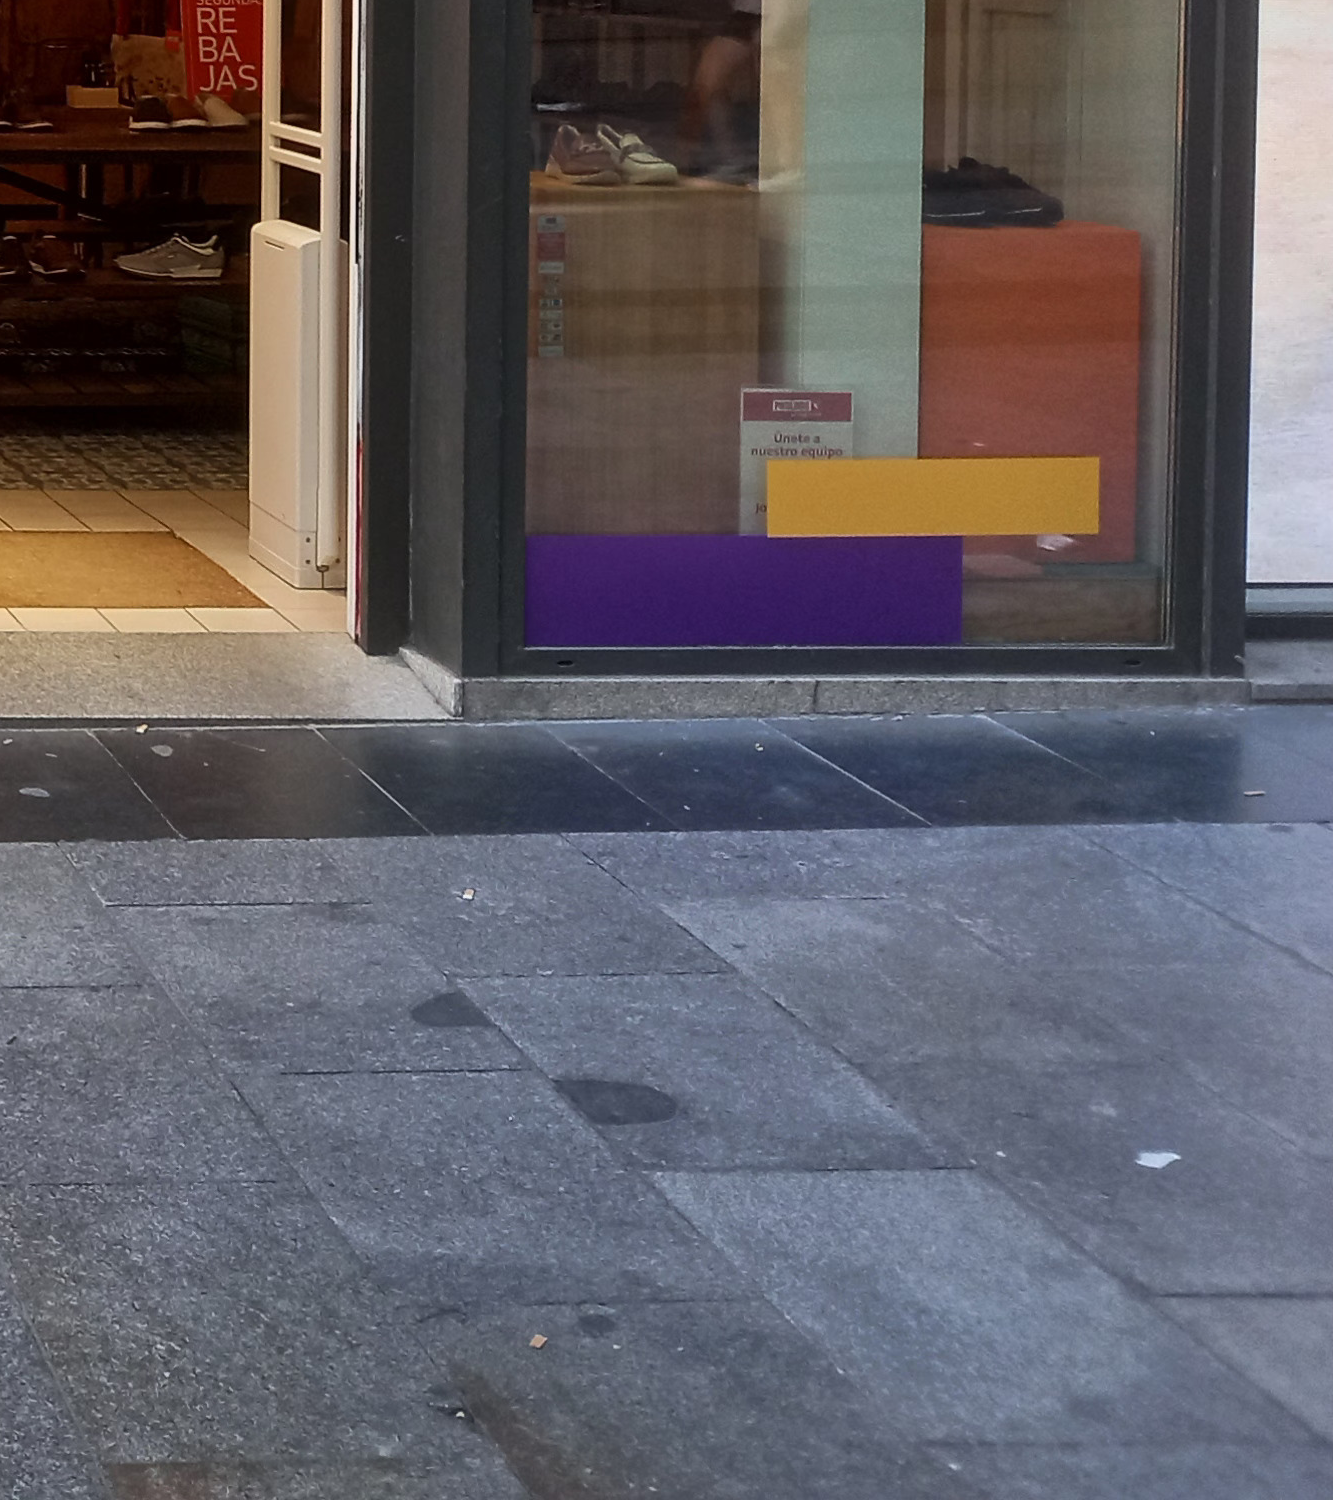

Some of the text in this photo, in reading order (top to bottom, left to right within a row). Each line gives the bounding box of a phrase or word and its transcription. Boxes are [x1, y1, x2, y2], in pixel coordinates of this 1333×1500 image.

[196, 7, 237, 33] RE
[198, 35, 241, 62] BA
[199, 64, 258, 92] JAS
[813, 434, 820, 443] a
[751, 445, 843, 459] nuestro equipo
